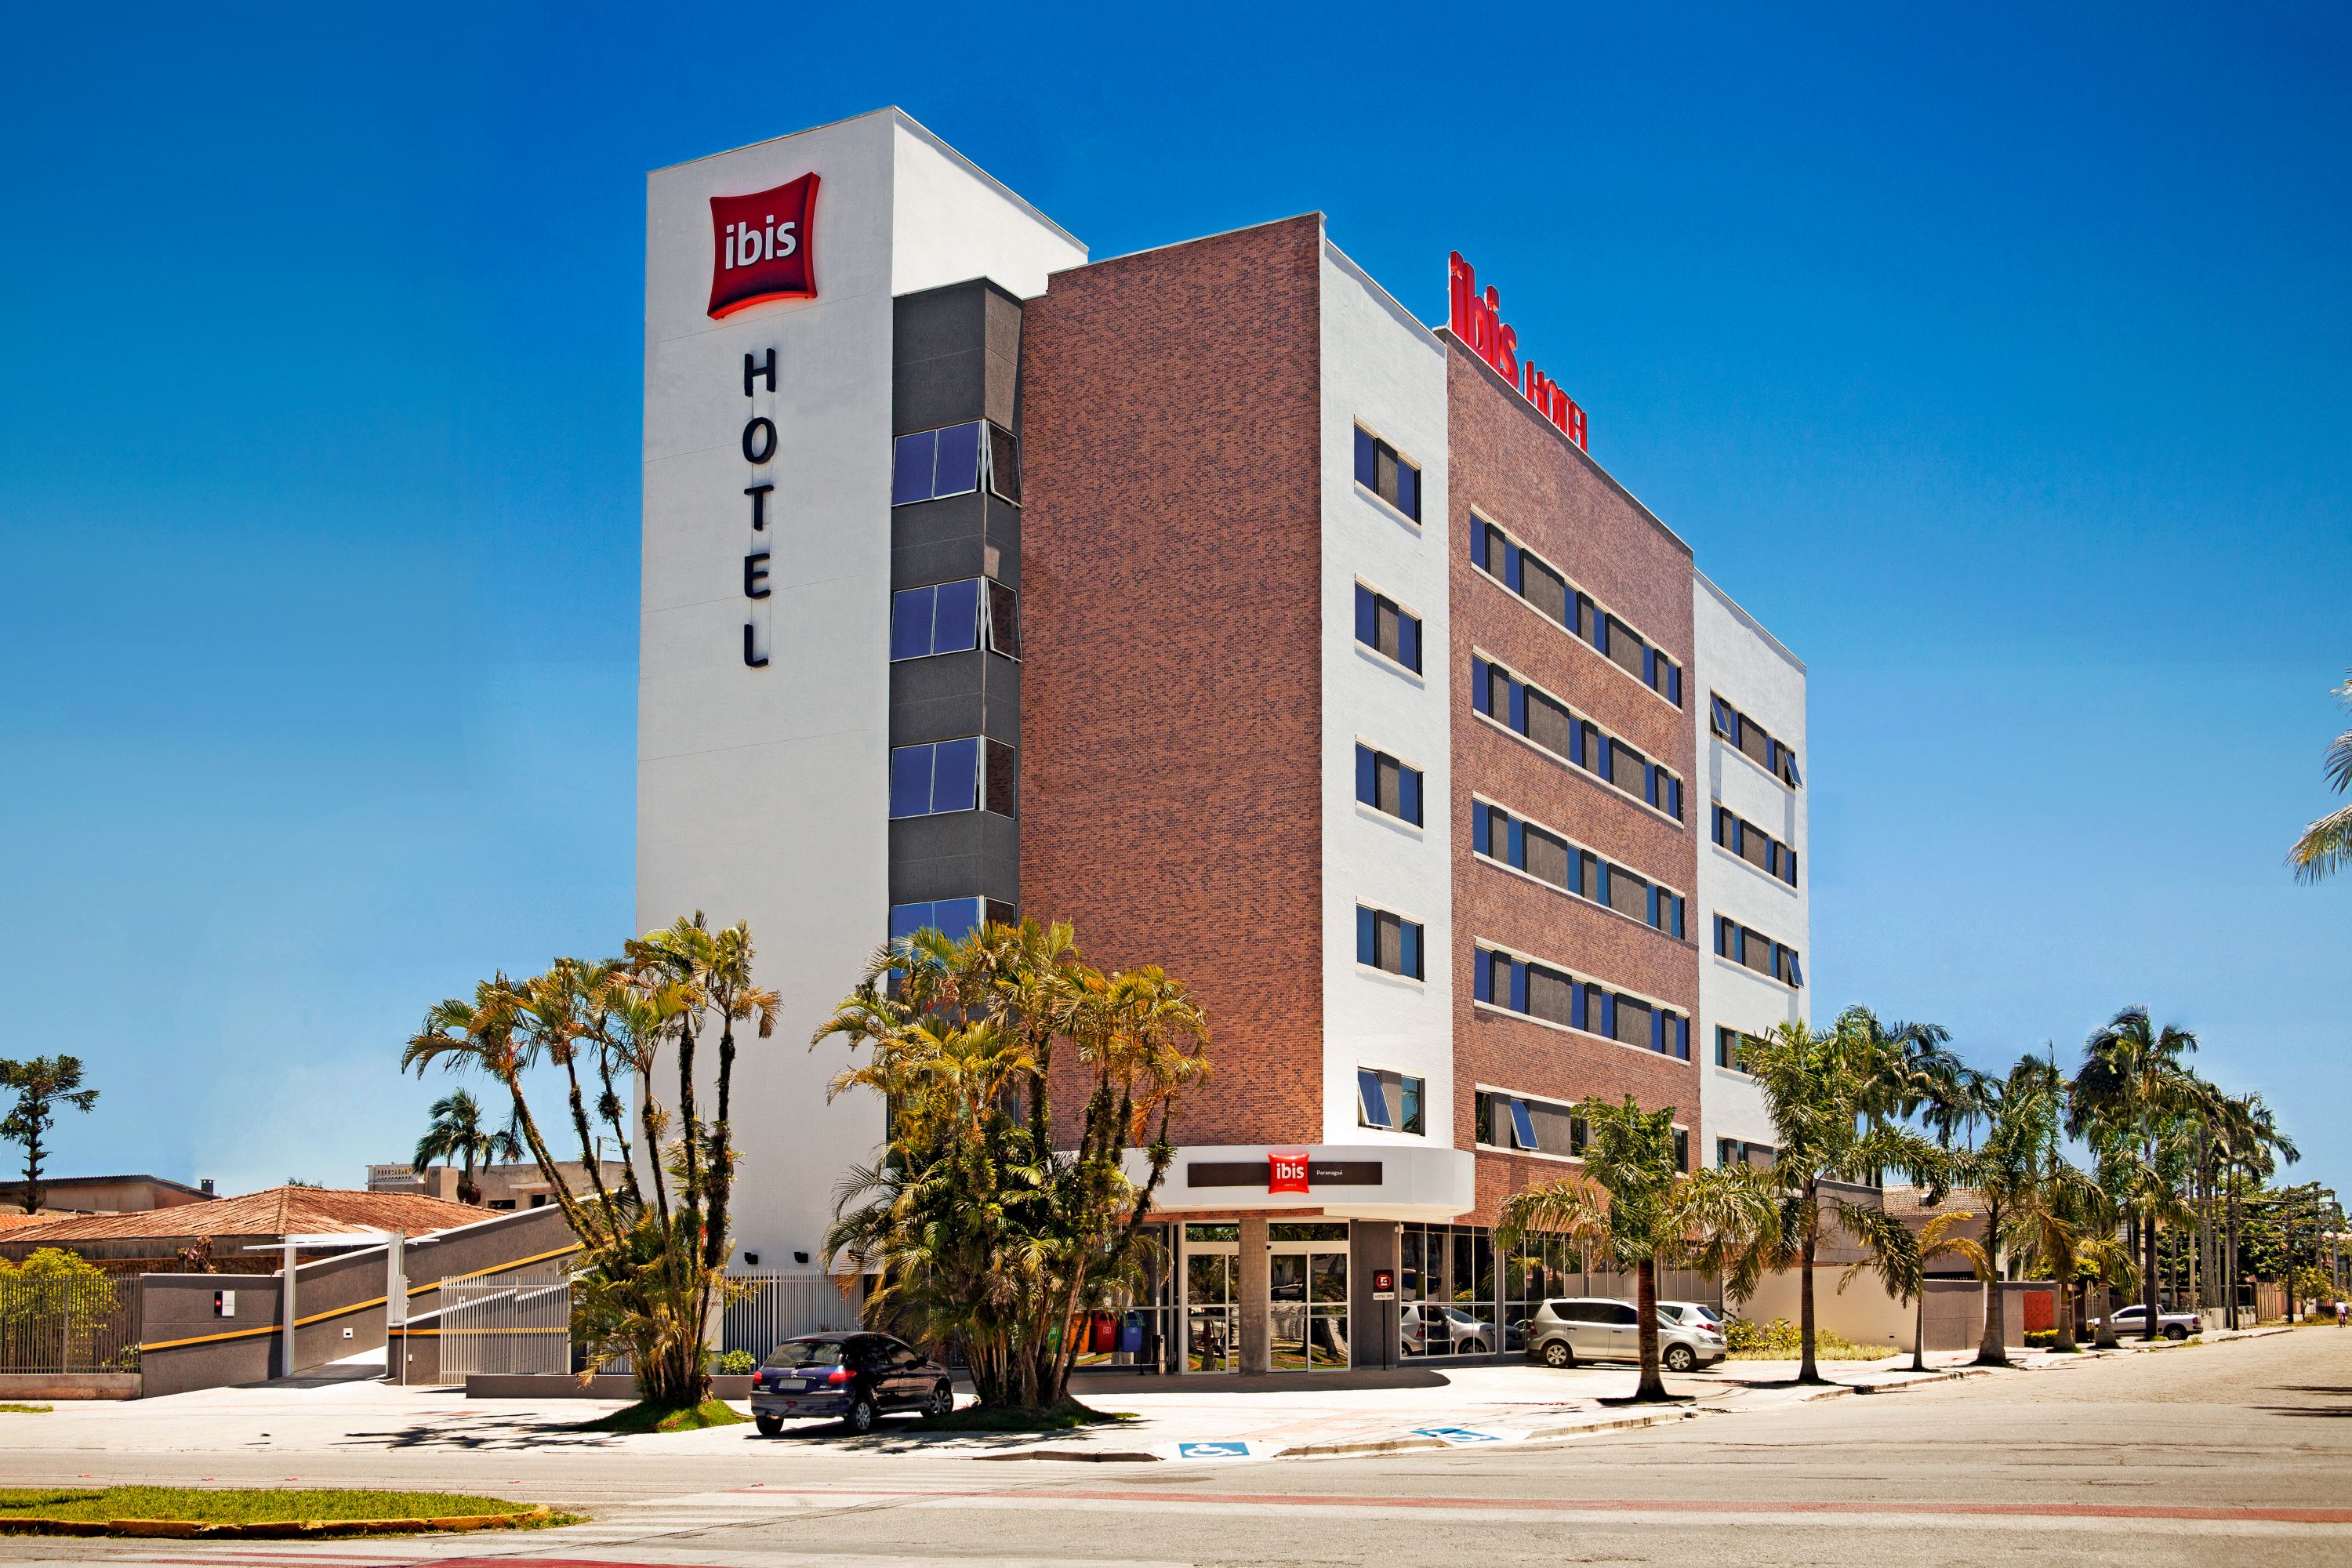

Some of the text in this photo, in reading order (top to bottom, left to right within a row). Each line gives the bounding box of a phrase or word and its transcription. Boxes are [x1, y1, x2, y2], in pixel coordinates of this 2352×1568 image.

[726, 215, 797, 269] ibis
[1450, 251, 1519, 390] ibis
[742, 348, 777, 667] HOTEL
[1276, 1163, 1305, 1179] ibis
